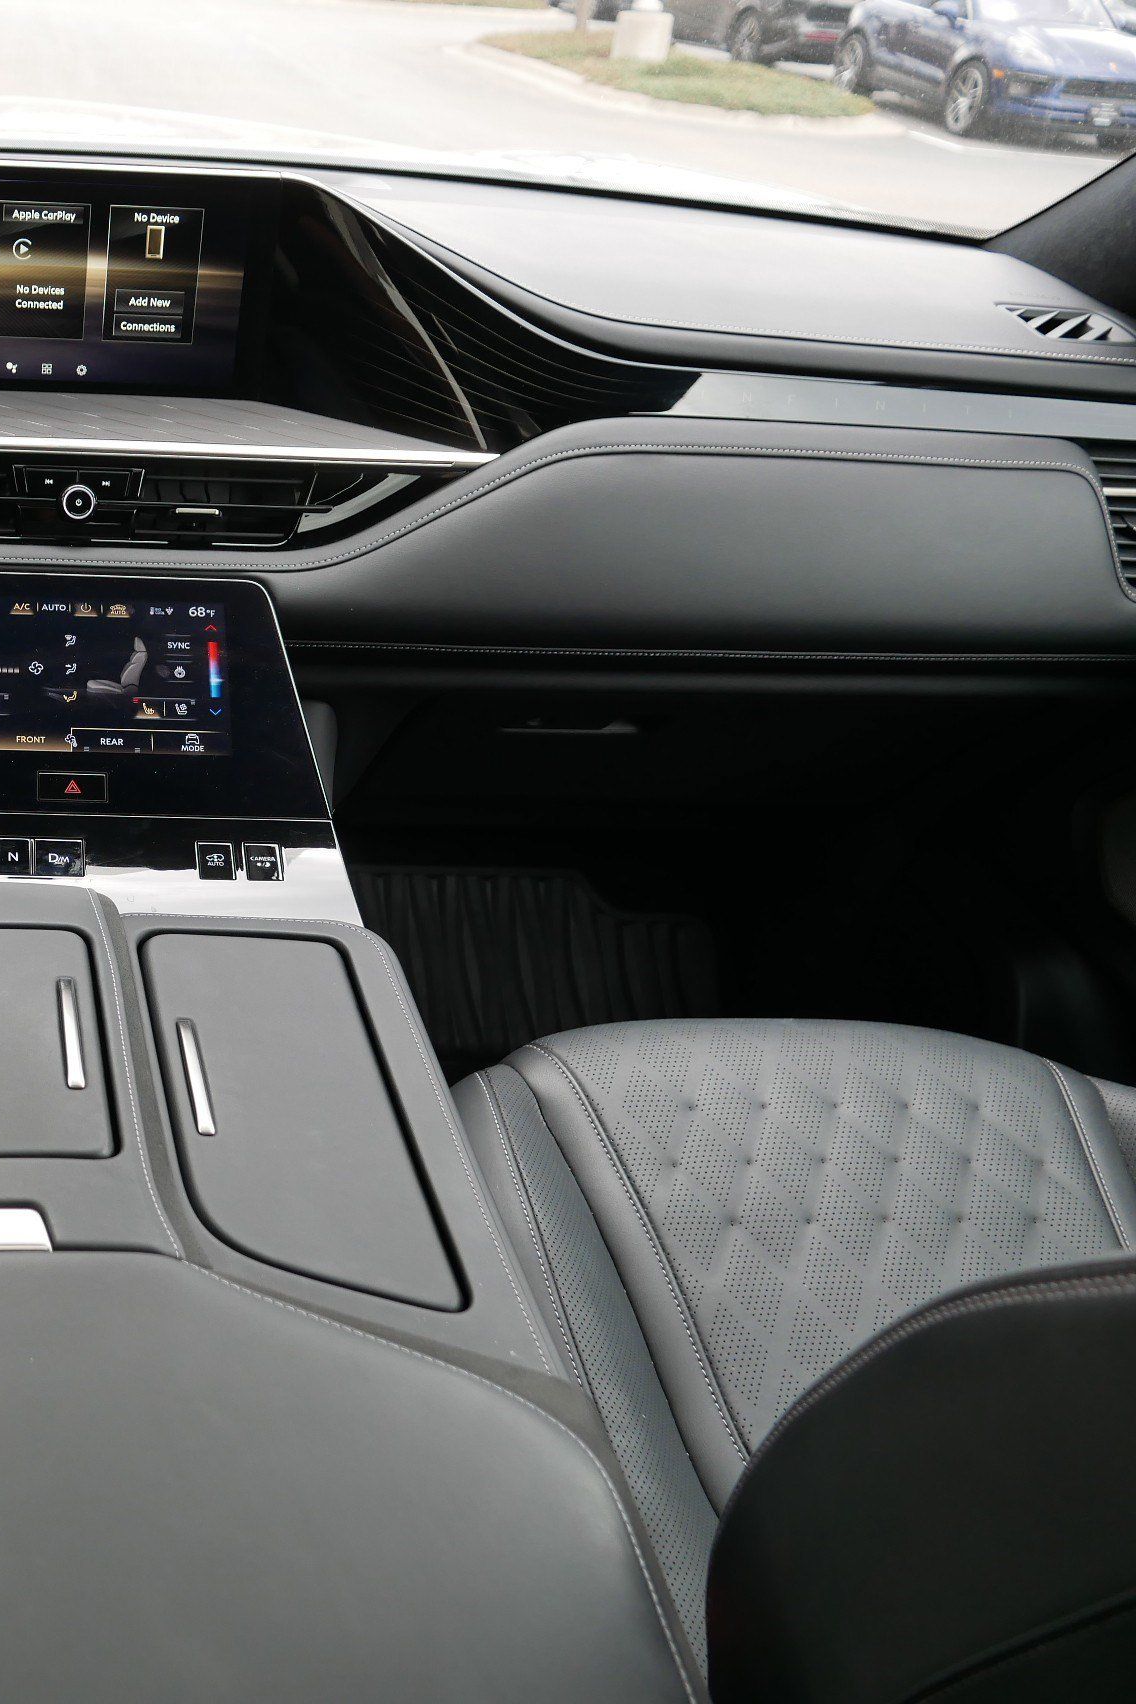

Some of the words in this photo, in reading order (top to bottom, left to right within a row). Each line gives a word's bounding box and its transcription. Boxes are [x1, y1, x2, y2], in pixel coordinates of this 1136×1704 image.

[12, 209, 40, 221] Apple
[41, 210, 76, 223] CarPlay
[134, 212, 148, 223] No
[149, 213, 180, 224] Device
[16, 285, 29, 295] No
[31, 285, 65, 296] Devices
[15, 299, 64, 310] Connected
[129, 297, 148, 307] Add
[150, 298, 171, 308] New
[120, 321, 175, 332] Connections
[13, 603, 31, 611] A/C
[41, 603, 67, 612] AUTO
[167, 641, 191, 650] SYNC
[16, 735, 46, 744] FRONT
[100, 738, 124, 746] REAR
[7, 852, 19, 862] N
